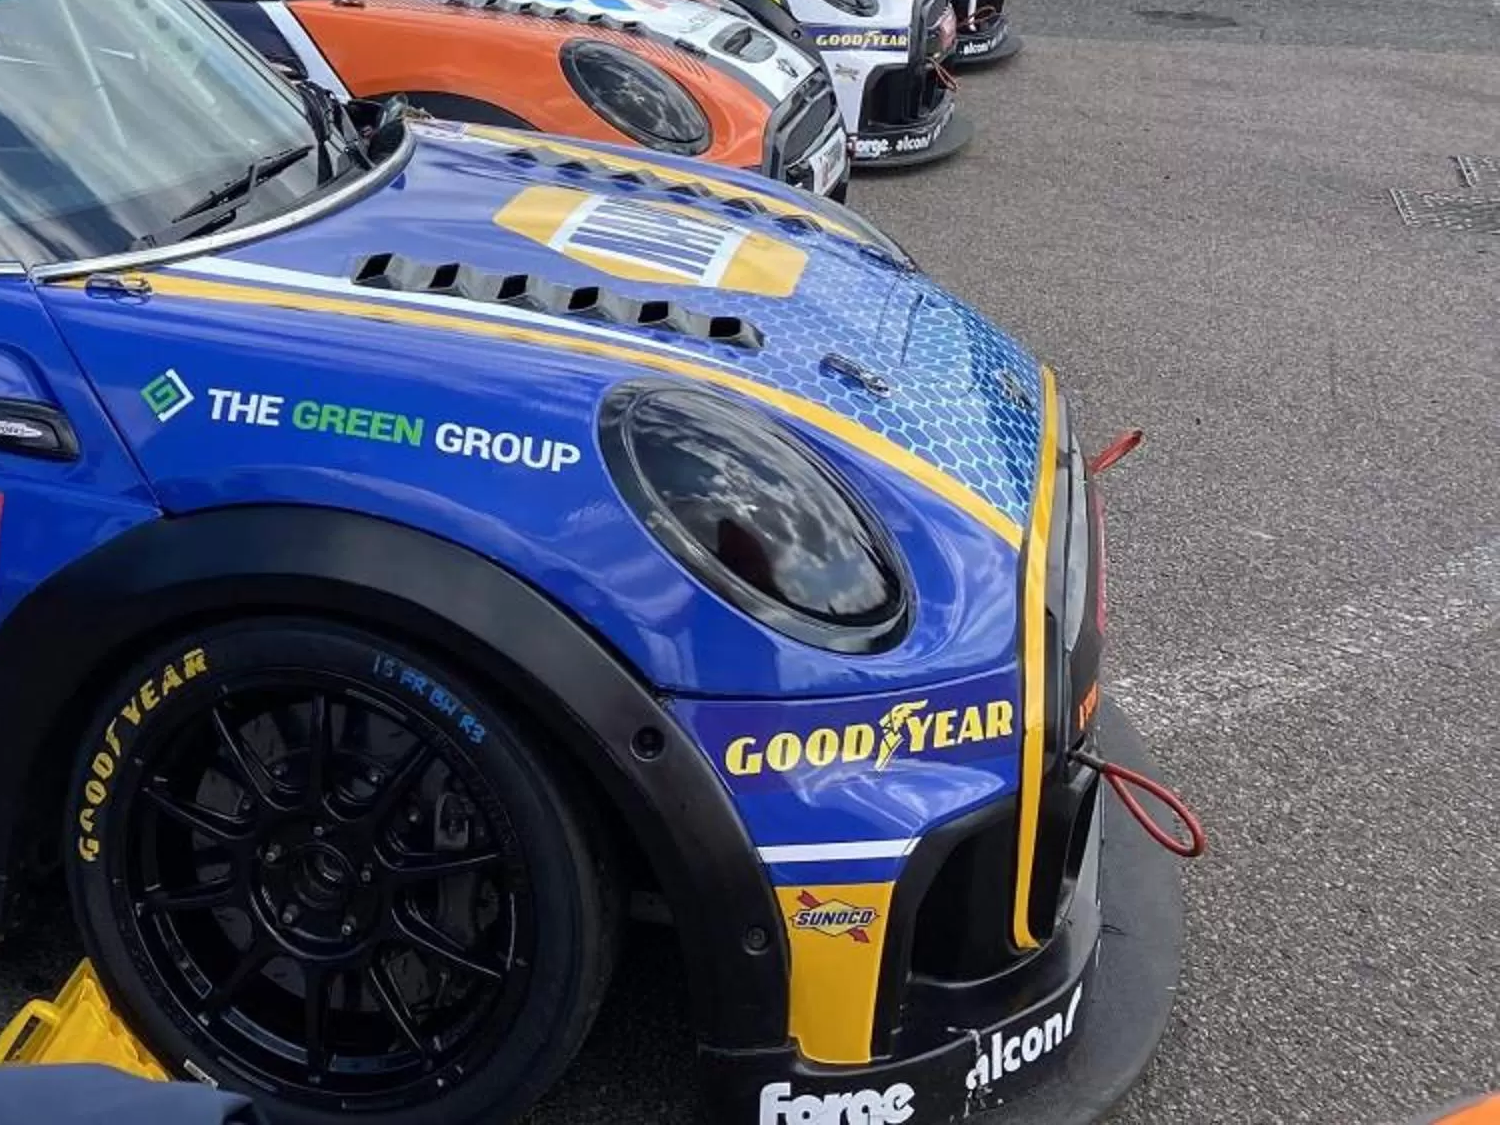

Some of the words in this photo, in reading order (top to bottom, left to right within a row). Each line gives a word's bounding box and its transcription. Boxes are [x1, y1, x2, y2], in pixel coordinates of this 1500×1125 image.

[207, 388, 283, 427] THE
[292, 400, 424, 448] GREEN
[435, 422, 581, 474] GROUP
[796, 907, 873, 928] SUNOCO
[965, 1020, 1063, 1089] alcon
